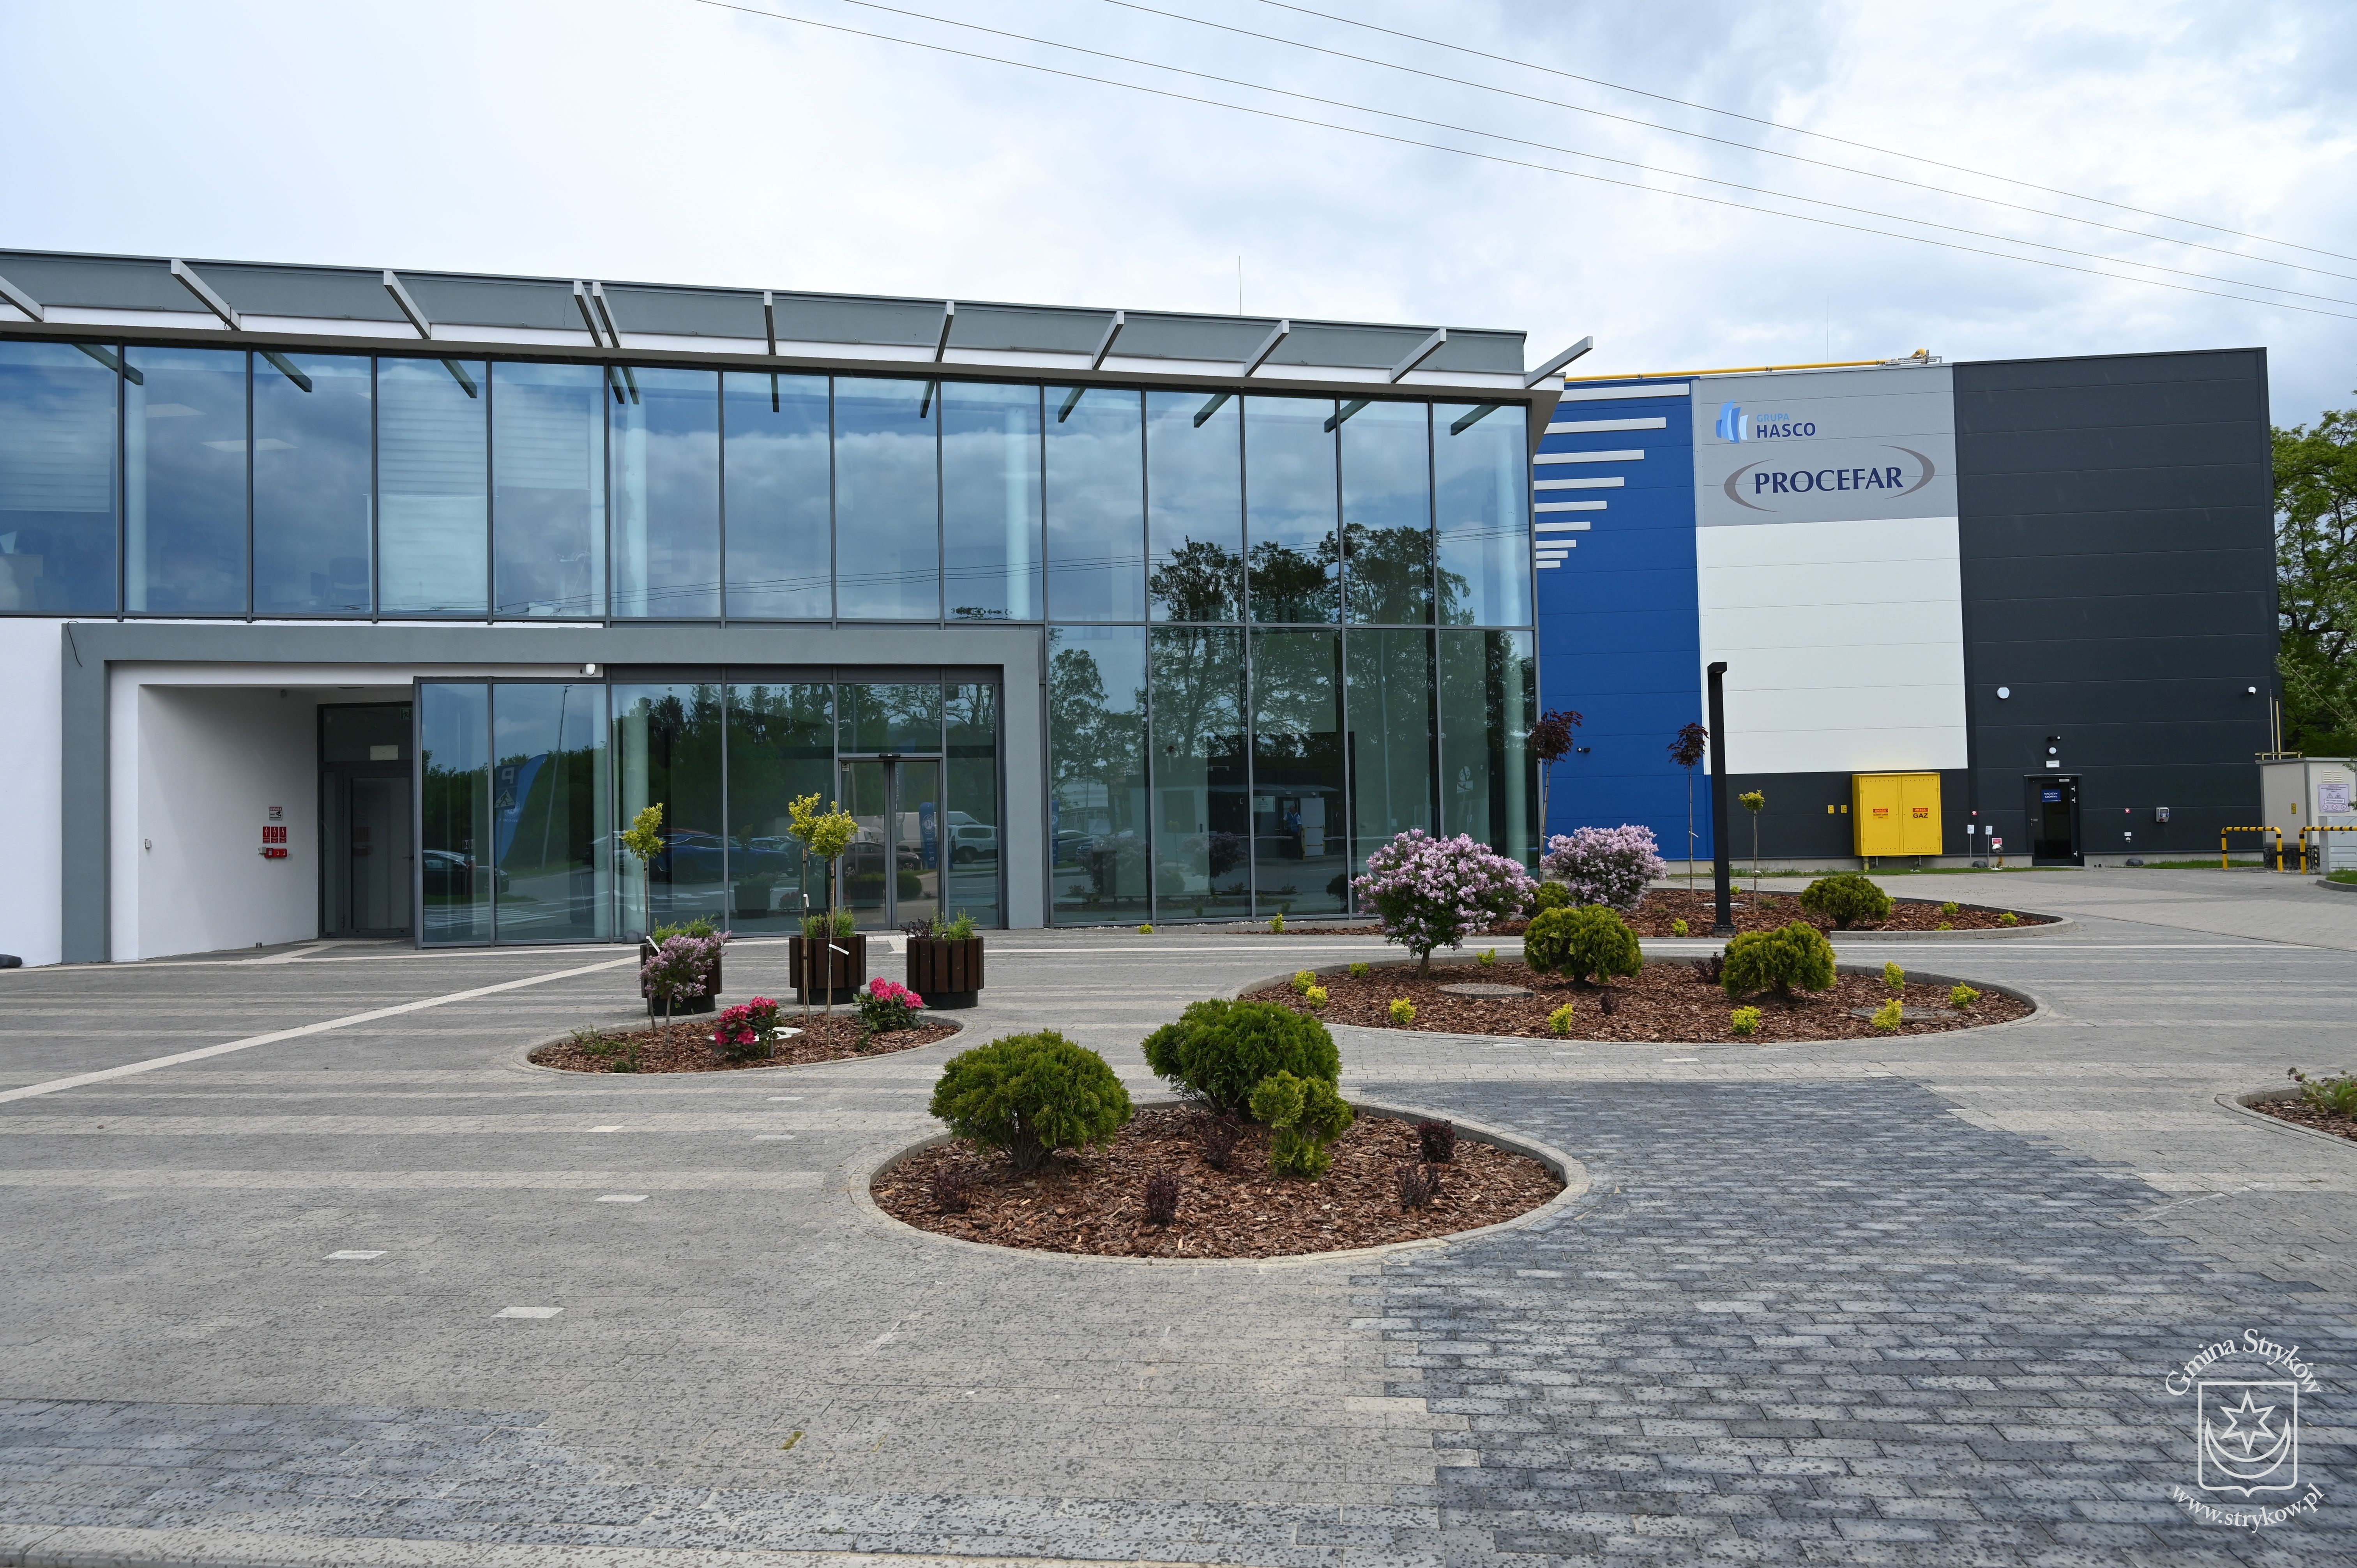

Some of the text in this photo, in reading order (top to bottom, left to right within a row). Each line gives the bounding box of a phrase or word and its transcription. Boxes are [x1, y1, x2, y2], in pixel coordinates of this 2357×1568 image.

[1757, 413, 1790, 422] GRUPA
[1757, 422, 1816, 438] HASCO
[1755, 467, 1904, 494] PROCEFAR
